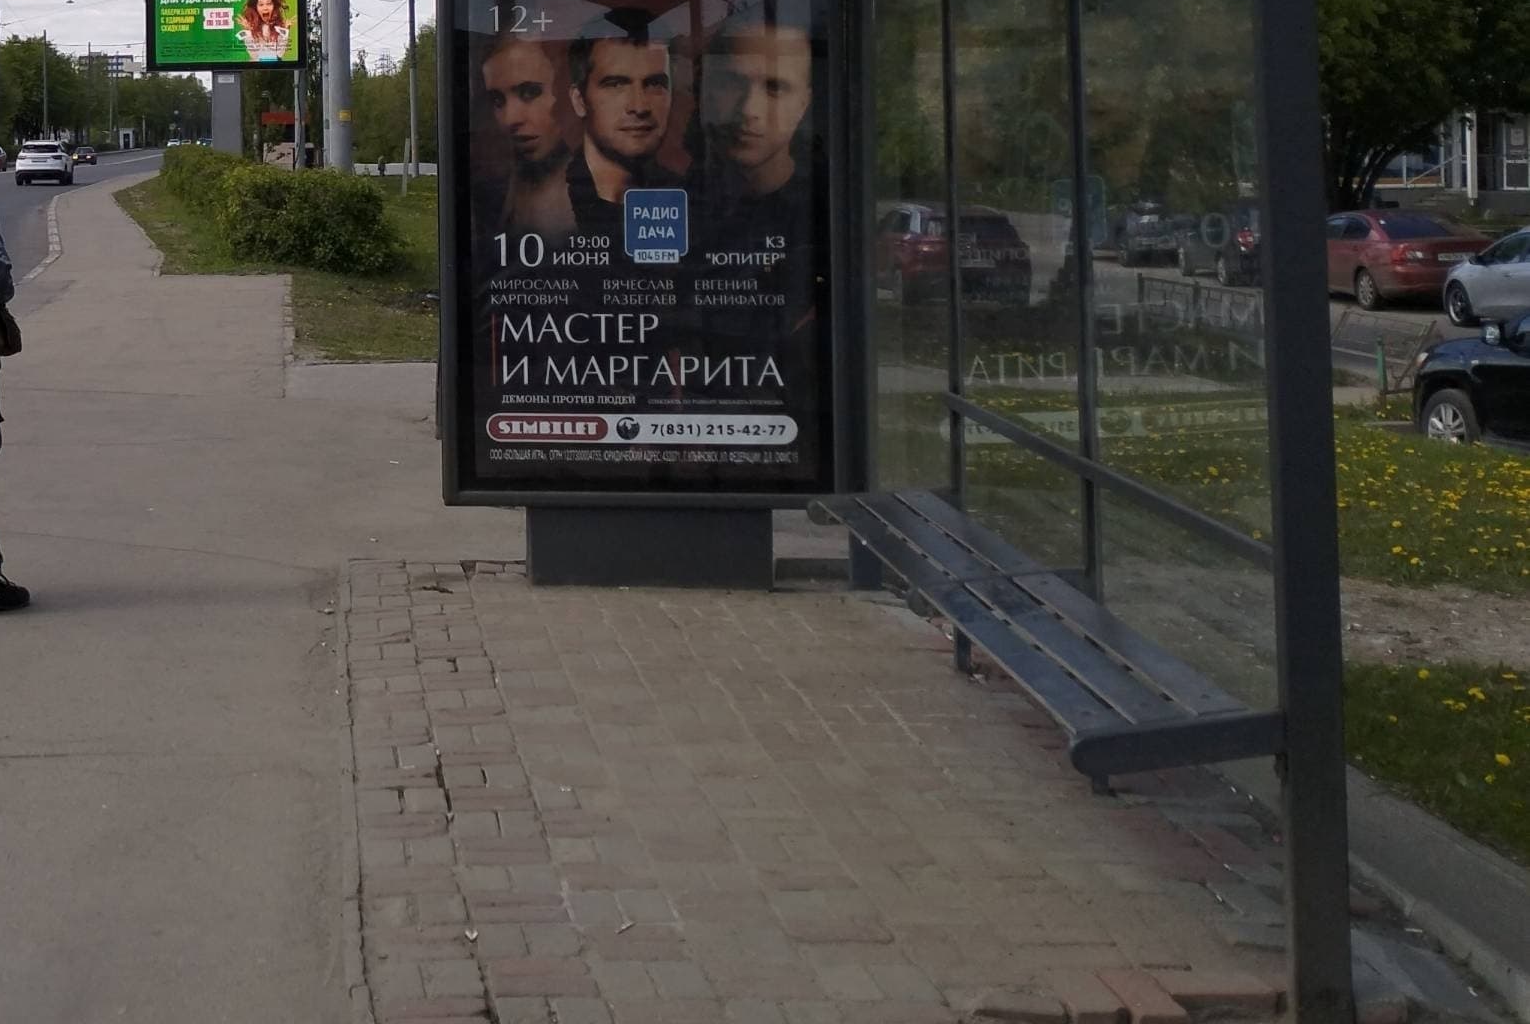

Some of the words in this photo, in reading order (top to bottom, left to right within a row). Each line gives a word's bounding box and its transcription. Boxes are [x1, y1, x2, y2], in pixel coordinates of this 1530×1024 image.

[489, 4, 553, 34] 12+
[633, 206, 679, 221] РАДИО
[637, 225, 676, 240] ДАЧА
[569, 235, 610, 249] 19:00
[766, 235, 786, 249] КЗ
[493, 233, 545, 268] 10
[553, 251, 610, 266] ИЮНЯ
[706, 251, 786, 266] "ЮПИТЕР"
[490, 279, 580, 291] МИРОСЛАВА
[603, 279, 675, 291] ВЯЧЕСЛАВ
[694, 278, 758, 291] ЕВГЕНИЙ
[490, 294, 569, 306] КАРПОВИЧ
[603, 294, 677, 306] РАЗБЕГАЕВ
[694, 293, 786, 306] БАНИФАТОВ
[500, 313, 659, 344] МАСТЕР
[502, 356, 530, 387] И
[544, 355, 785, 387] МАРГАРИТА
[502, 394, 550, 405] ДЕМОНЫ
[552, 394, 595, 405] ПРОТИВ
[597, 393, 636, 405] ЛЮДЕЙ
[498, 420, 599, 436] SIMBILET
[650, 423, 702, 437] 7(831)
[706, 423, 787, 437] 215-42-77
